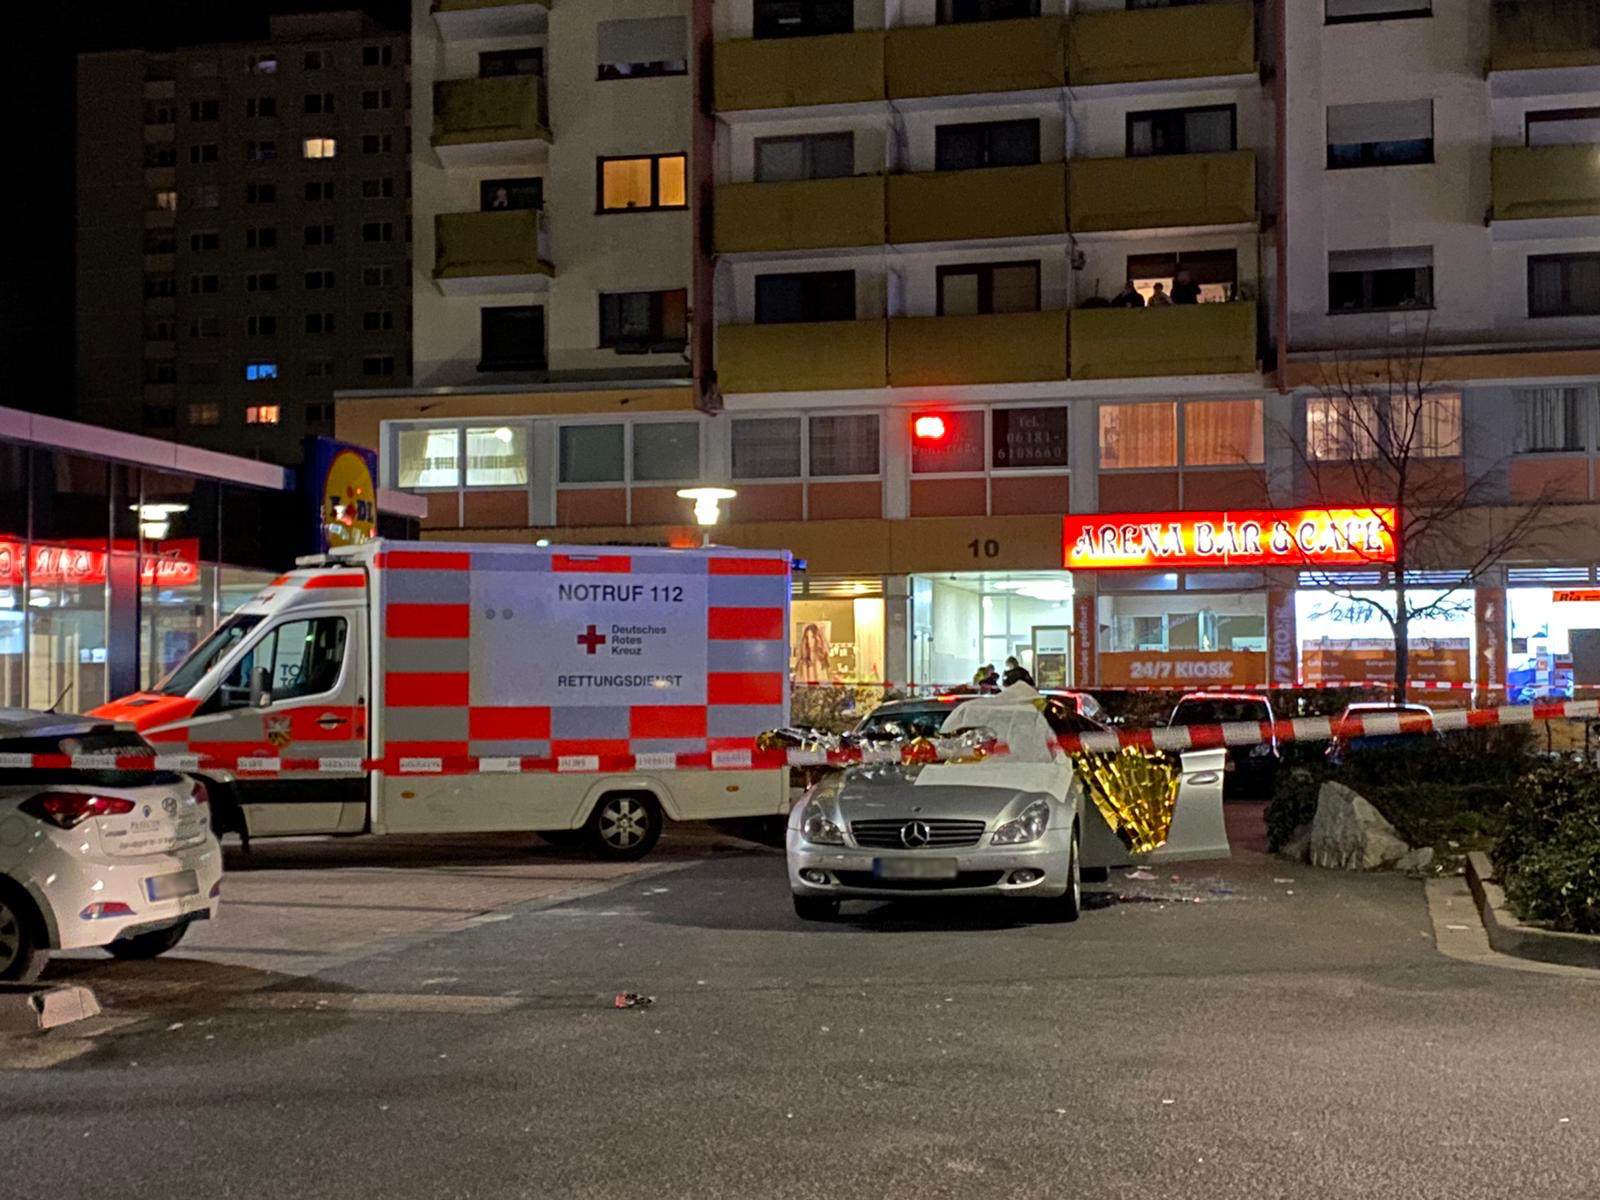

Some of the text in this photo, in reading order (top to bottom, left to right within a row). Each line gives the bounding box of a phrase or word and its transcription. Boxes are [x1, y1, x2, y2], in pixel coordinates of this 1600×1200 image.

[968, 538, 999, 558] 10
[1073, 522, 1186, 557] ARENA
[1194, 521, 1263, 556] BAR
[1271, 521, 1289, 555] &
[558, 583, 684, 602] NOTRUF 112
[611, 624, 667, 635] Deutsches
[611, 635, 642, 645] Rotes
[611, 646, 642, 655] Kreuz
[1130, 660, 1233, 679] 24/7 KIOSK
